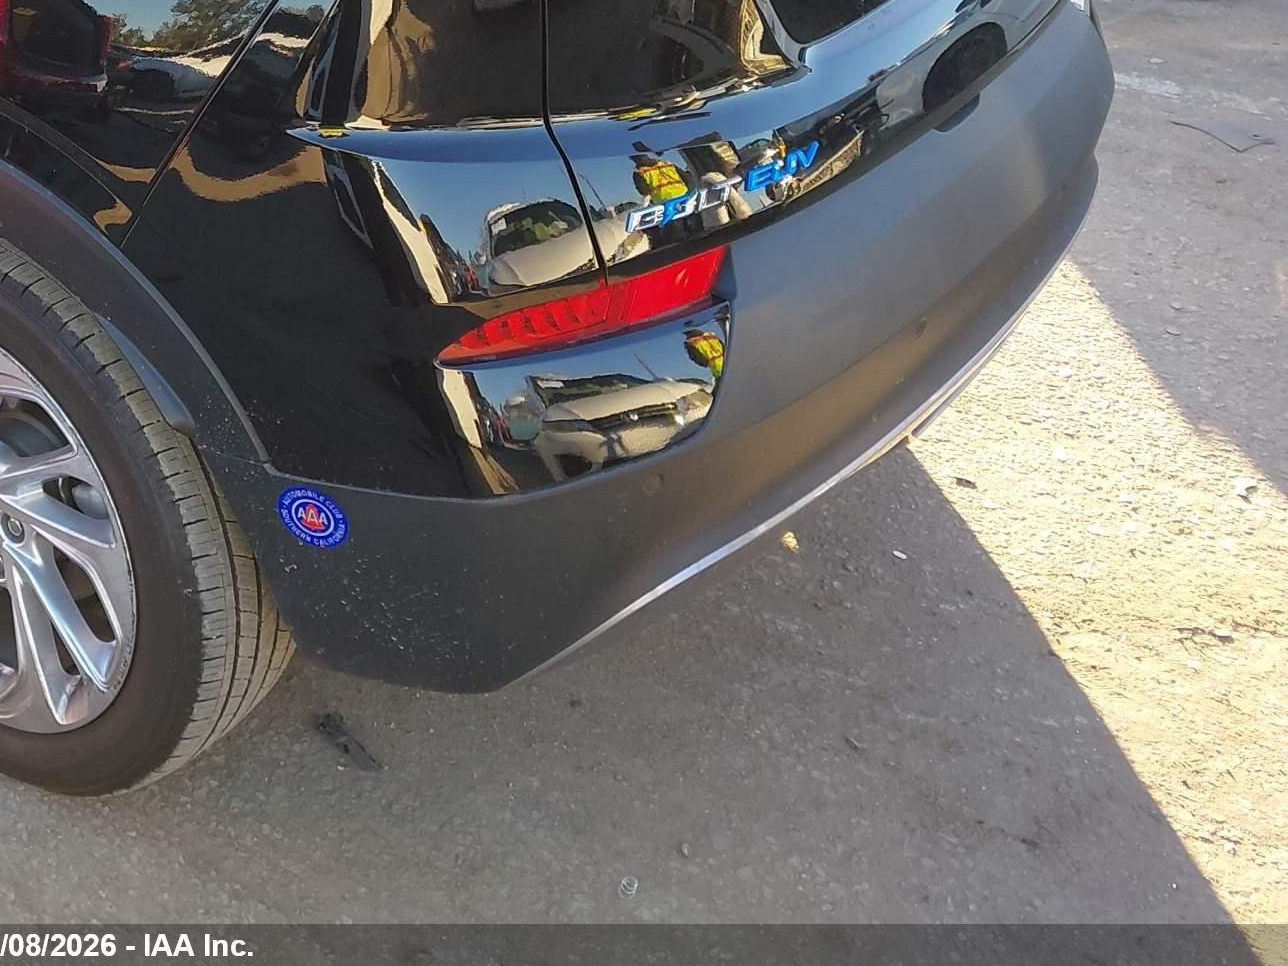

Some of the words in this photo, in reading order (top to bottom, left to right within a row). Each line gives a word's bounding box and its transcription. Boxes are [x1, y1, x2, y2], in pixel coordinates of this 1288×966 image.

[743, 140, 821, 192] EUV
[282, 489, 324, 506] AUTOMOBILE
[325, 500, 343, 519] CLUB
[297, 506, 328, 525] AAA
